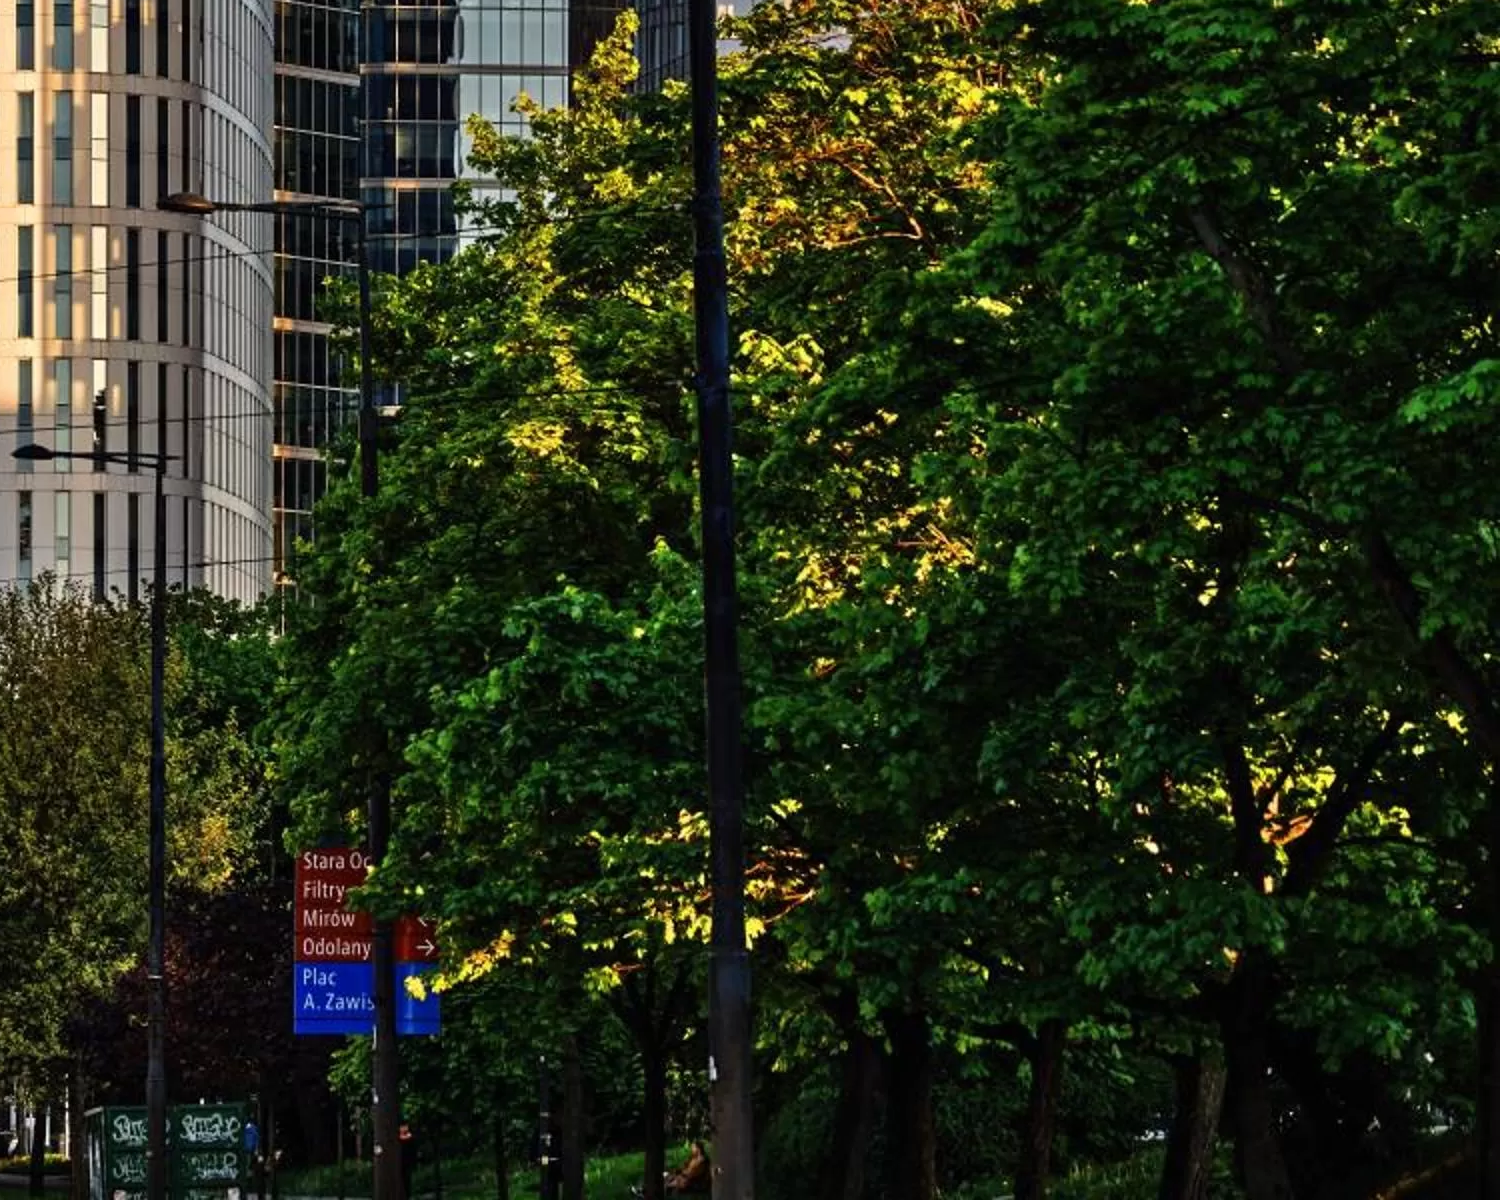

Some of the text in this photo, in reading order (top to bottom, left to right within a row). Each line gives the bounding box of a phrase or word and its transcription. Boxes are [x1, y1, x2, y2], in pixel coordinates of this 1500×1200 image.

[303, 852, 345, 870] Stara
[303, 880, 345, 903] Filtry
[303, 909, 356, 928] Mirów
[303, 938, 372, 961] Odolany
[303, 968, 337, 987] Plac
[303, 992, 322, 1010] A.
